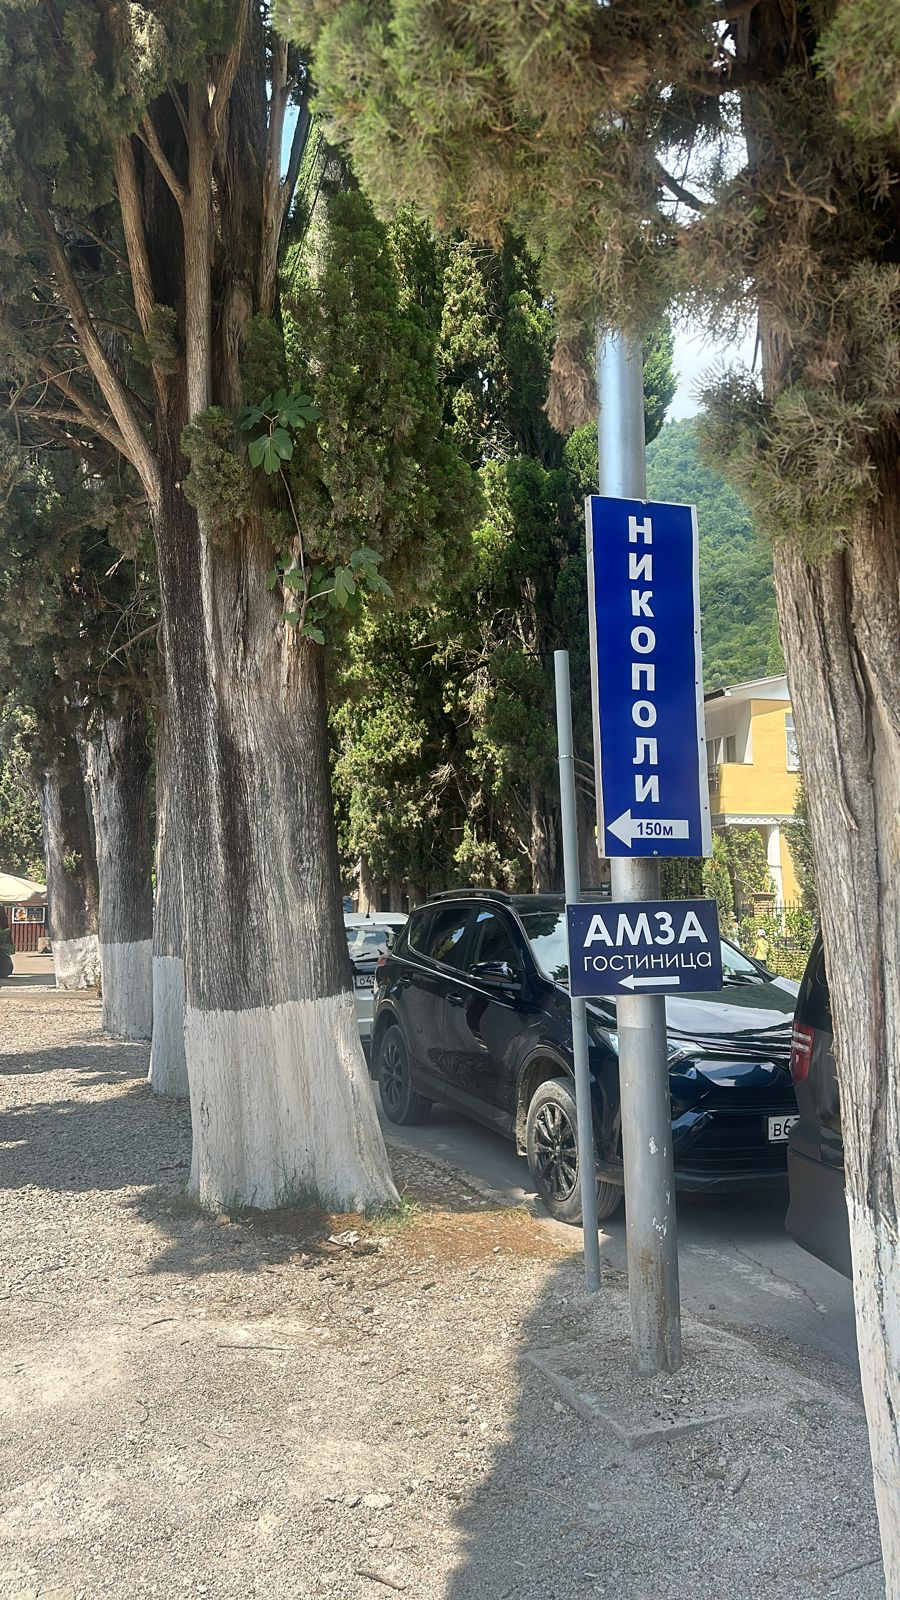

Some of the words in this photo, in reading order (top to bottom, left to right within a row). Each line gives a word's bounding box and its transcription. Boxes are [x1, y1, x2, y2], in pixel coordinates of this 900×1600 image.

[628, 515, 660, 803] НИКОПОЛИ
[637, 822, 673, 836] 150м
[583, 911, 708, 948] АМЗА
[583, 951, 712, 972] гостиница
